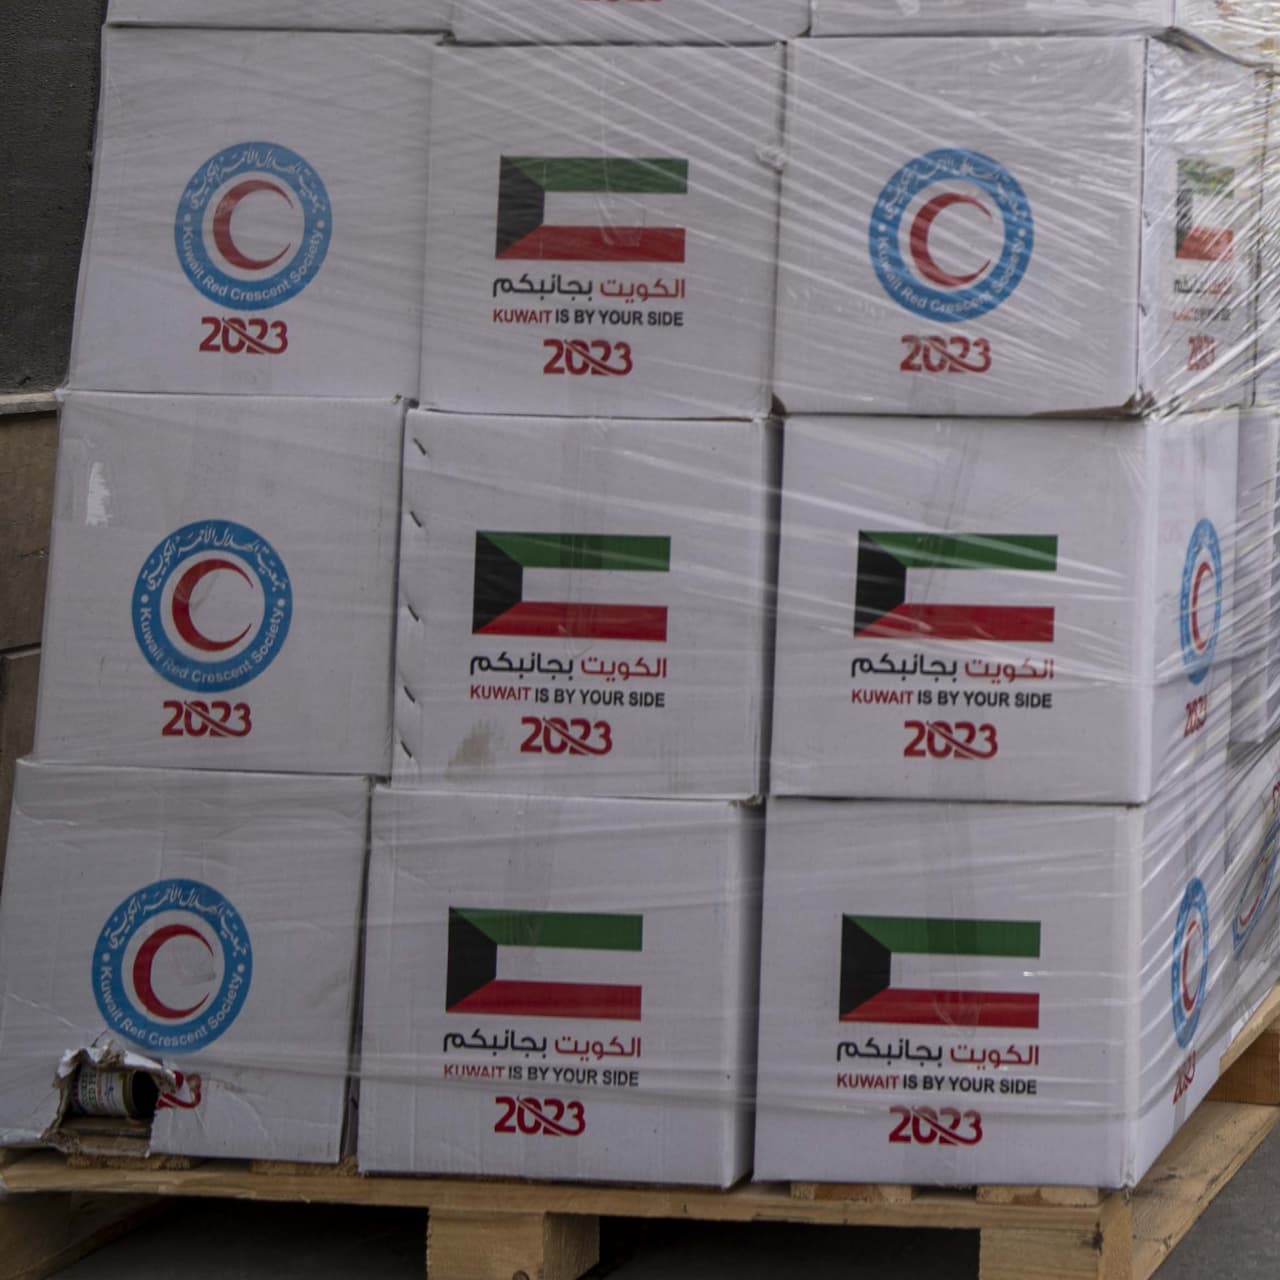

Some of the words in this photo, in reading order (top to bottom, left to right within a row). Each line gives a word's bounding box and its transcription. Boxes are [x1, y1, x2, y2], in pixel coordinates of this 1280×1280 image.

[182, 225, 209, 280] Kuwait
[201, 272, 231, 299] Red
[229, 278, 291, 304] Crescent
[287, 229, 323, 287] Society
[493, 273, 593, 301] بجانبكم
[600, 278, 685, 303] الكويت
[493, 309, 552, 324] KUWAIT
[556, 309, 569, 324] IS
[574, 309, 595, 324] BY
[598, 310, 643, 326] YOUR
[648, 311, 683, 327] SIDE
[199, 316, 288, 354] 2023
[543, 339, 633, 376] 2023
[900, 335, 991, 373] 2023
[139, 607, 168, 662] Kuwait
[161, 654, 192, 682] Red
[189, 658, 254, 685] Crescent
[249, 607, 285, 666] Society
[470, 652, 573, 681] بجانبكم
[581, 657, 667, 682] الكويت
[851, 653, 957, 683] بجانبكم
[964, 658, 1054, 683] الكويت
[470, 685, 531, 701] KUWAIT
[535, 688, 549, 703] IS
[554, 689, 575, 704] BY
[580, 689, 624, 706] YOUR
[629, 691, 665, 708] SIDE
[851, 689, 913, 705] KUWAIT
[918, 690, 932, 705] IS
[938, 691, 959, 706] BY
[963, 691, 1010, 708] YOUR
[1014, 692, 1052, 709] SIDE
[161, 700, 251, 736] 2023
[520, 716, 613, 756] 2023
[903, 720, 998, 760] 2023
[99, 965, 127, 1022] Kuwait
[119, 1014, 150, 1042] Red
[147, 1020, 212, 1047] Crescent
[208, 969, 245, 1029] Society
[443, 1029, 547, 1058] بجانبكم
[555, 1036, 641, 1061] الكويت
[836, 1037, 943, 1067] بجانبكم
[950, 1045, 1039, 1069] الكويت
[444, 1065, 504, 1079] KUWAIT
[509, 1066, 522, 1079] IS
[528, 1067, 549, 1080] BY
[553, 1067, 597, 1084] YOUR
[603, 1070, 638, 1087] SIDE
[837, 1073, 899, 1089] KUWAIT
[903, 1074, 918, 1089] IS
[923, 1076, 945, 1090] BY
[949, 1076, 995, 1093] YOUR
[1000, 1079, 1037, 1095] SIDE
[494, 1096, 586, 1137] 2023
[889, 1106, 983, 1146] 2023
